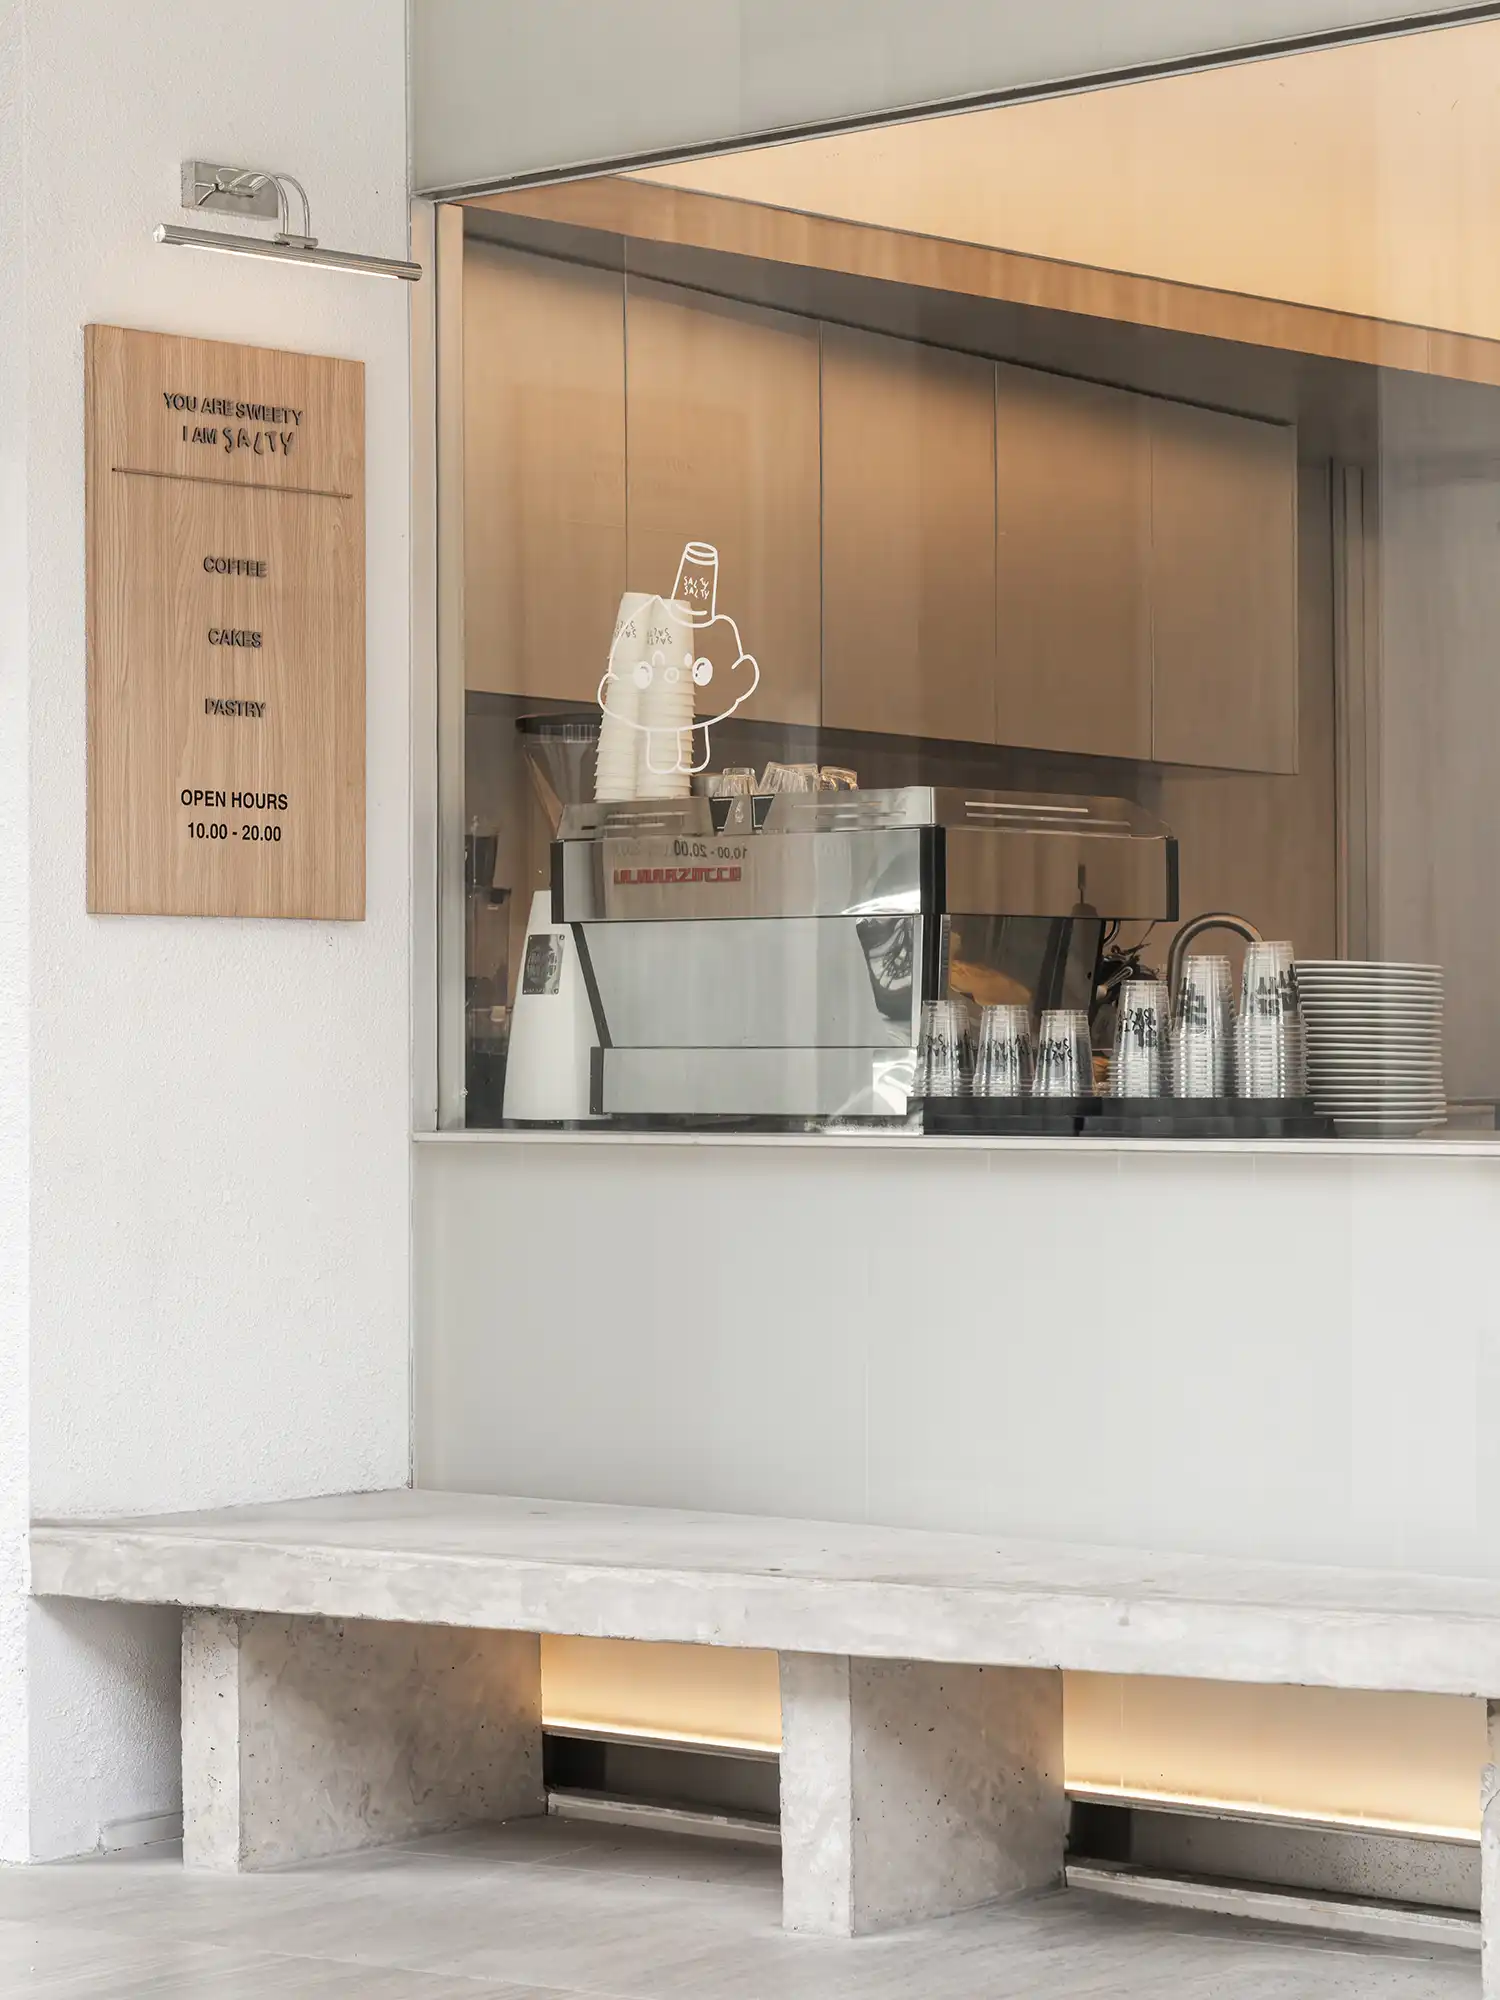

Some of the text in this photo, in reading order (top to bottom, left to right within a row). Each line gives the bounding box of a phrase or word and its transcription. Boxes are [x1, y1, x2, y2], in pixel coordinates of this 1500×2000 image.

[163, 391, 303, 425] YOU ARE SWEETY
[182, 425, 294, 456] I AM SALTY
[203, 556, 268, 578] COFFEE
[208, 628, 263, 649] CAKES
[204, 698, 266, 718] PASTRY
[180, 788, 288, 810] OPEN HOURS
[187, 822, 228, 840] 10.00
[242, 824, 281, 842] 20.00
